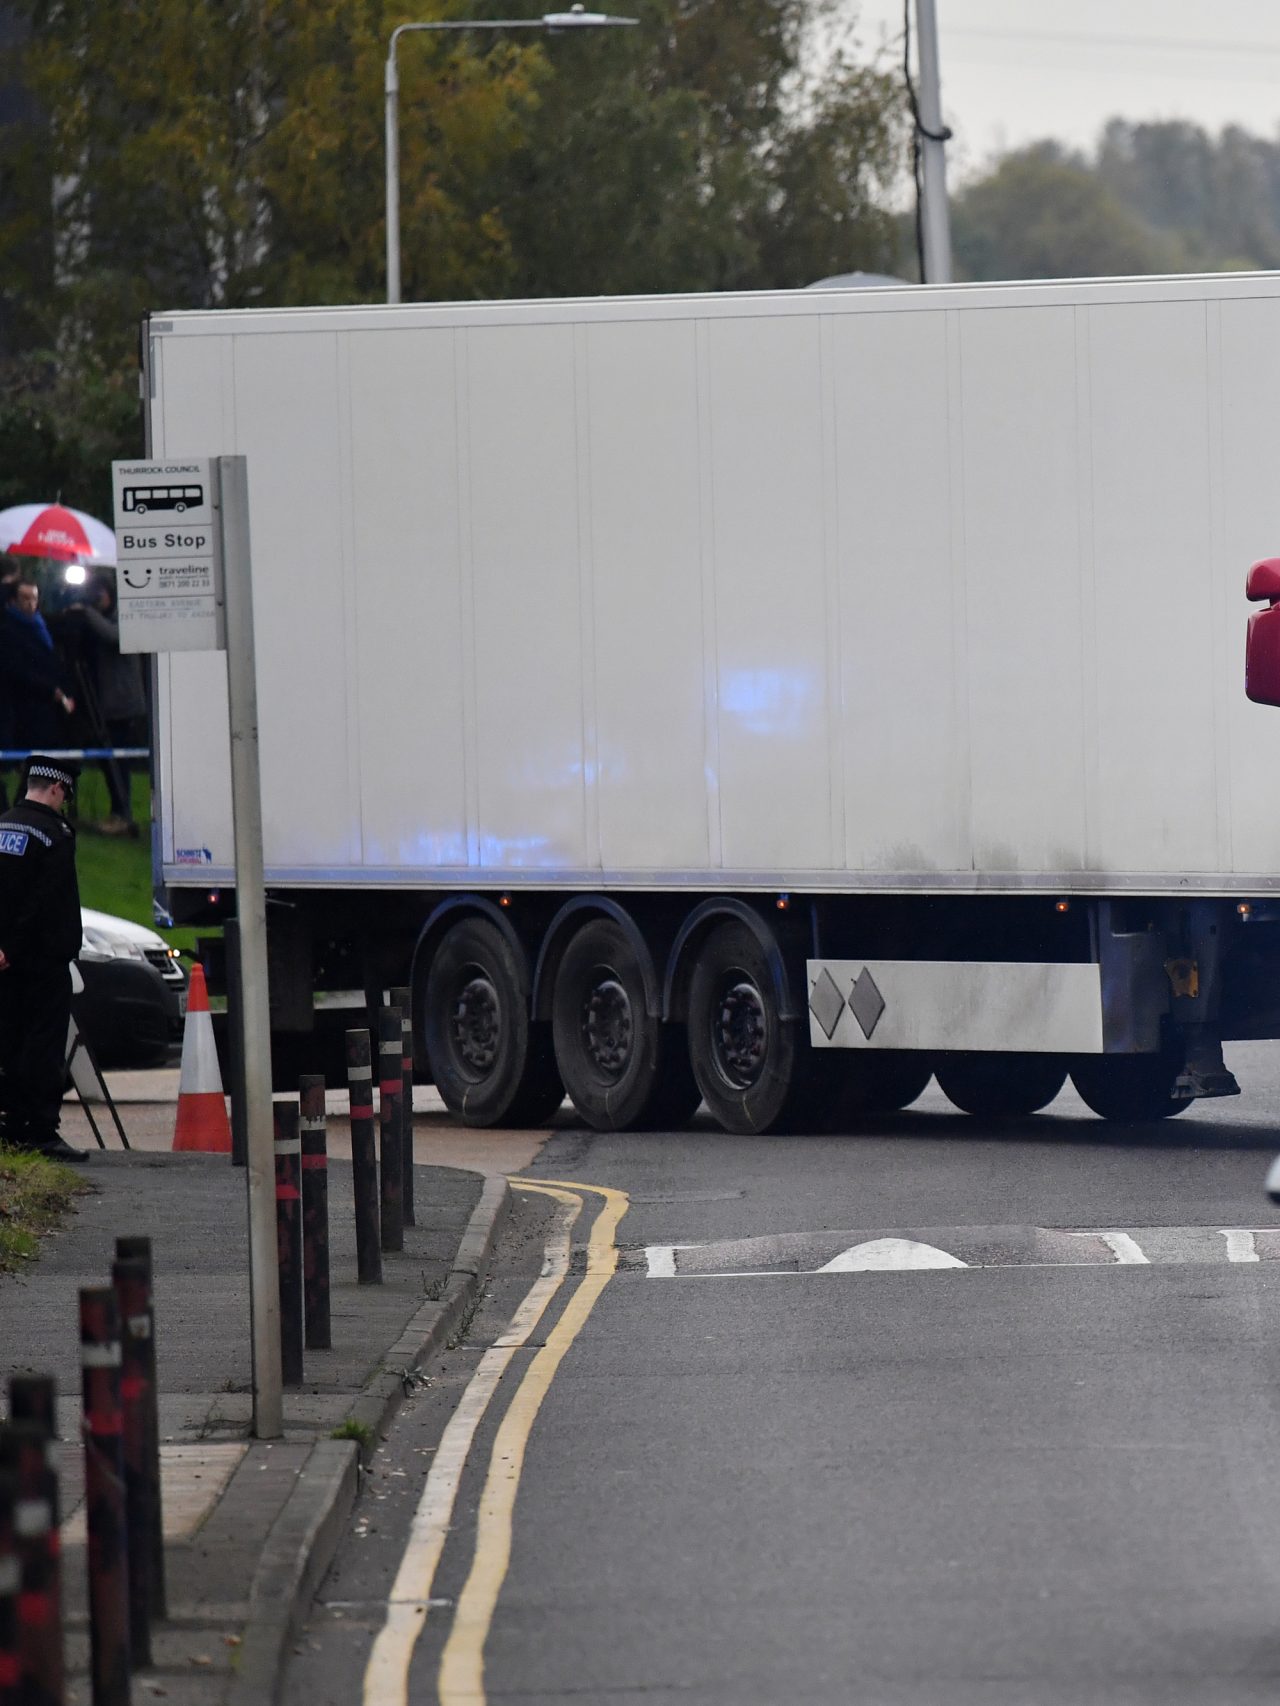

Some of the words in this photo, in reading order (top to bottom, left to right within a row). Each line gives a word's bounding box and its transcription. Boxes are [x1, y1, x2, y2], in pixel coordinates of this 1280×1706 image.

[119, 467, 163, 475] THURROCK
[165, 465, 200, 474] COUNCIL
[123, 535, 157, 549] Bus
[165, 534, 206, 549] Stop
[159, 565, 209, 575] traveline
